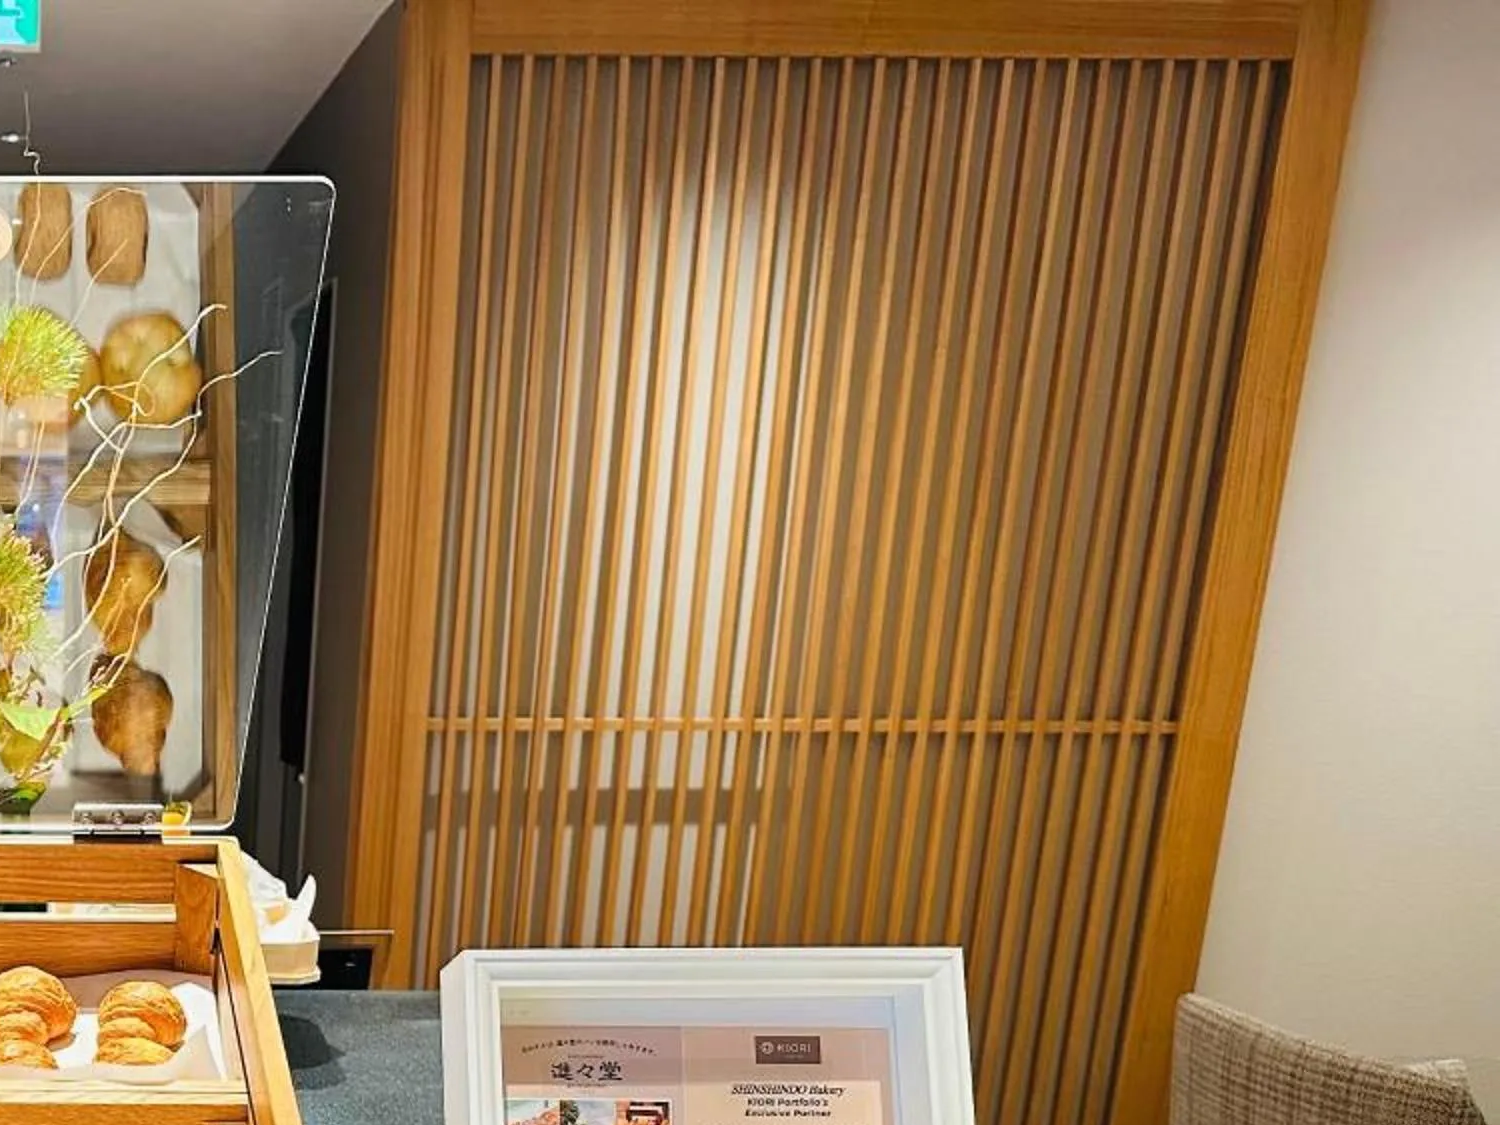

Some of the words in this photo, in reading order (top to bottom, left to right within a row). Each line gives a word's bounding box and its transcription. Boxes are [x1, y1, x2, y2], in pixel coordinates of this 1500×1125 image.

[776, 1043, 812, 1053] KIORI
[551, 1061, 623, 1081] 進々堂
[731, 1083, 807, 1096] SHINSHINDO
[809, 1083, 846, 1098] Bakery
